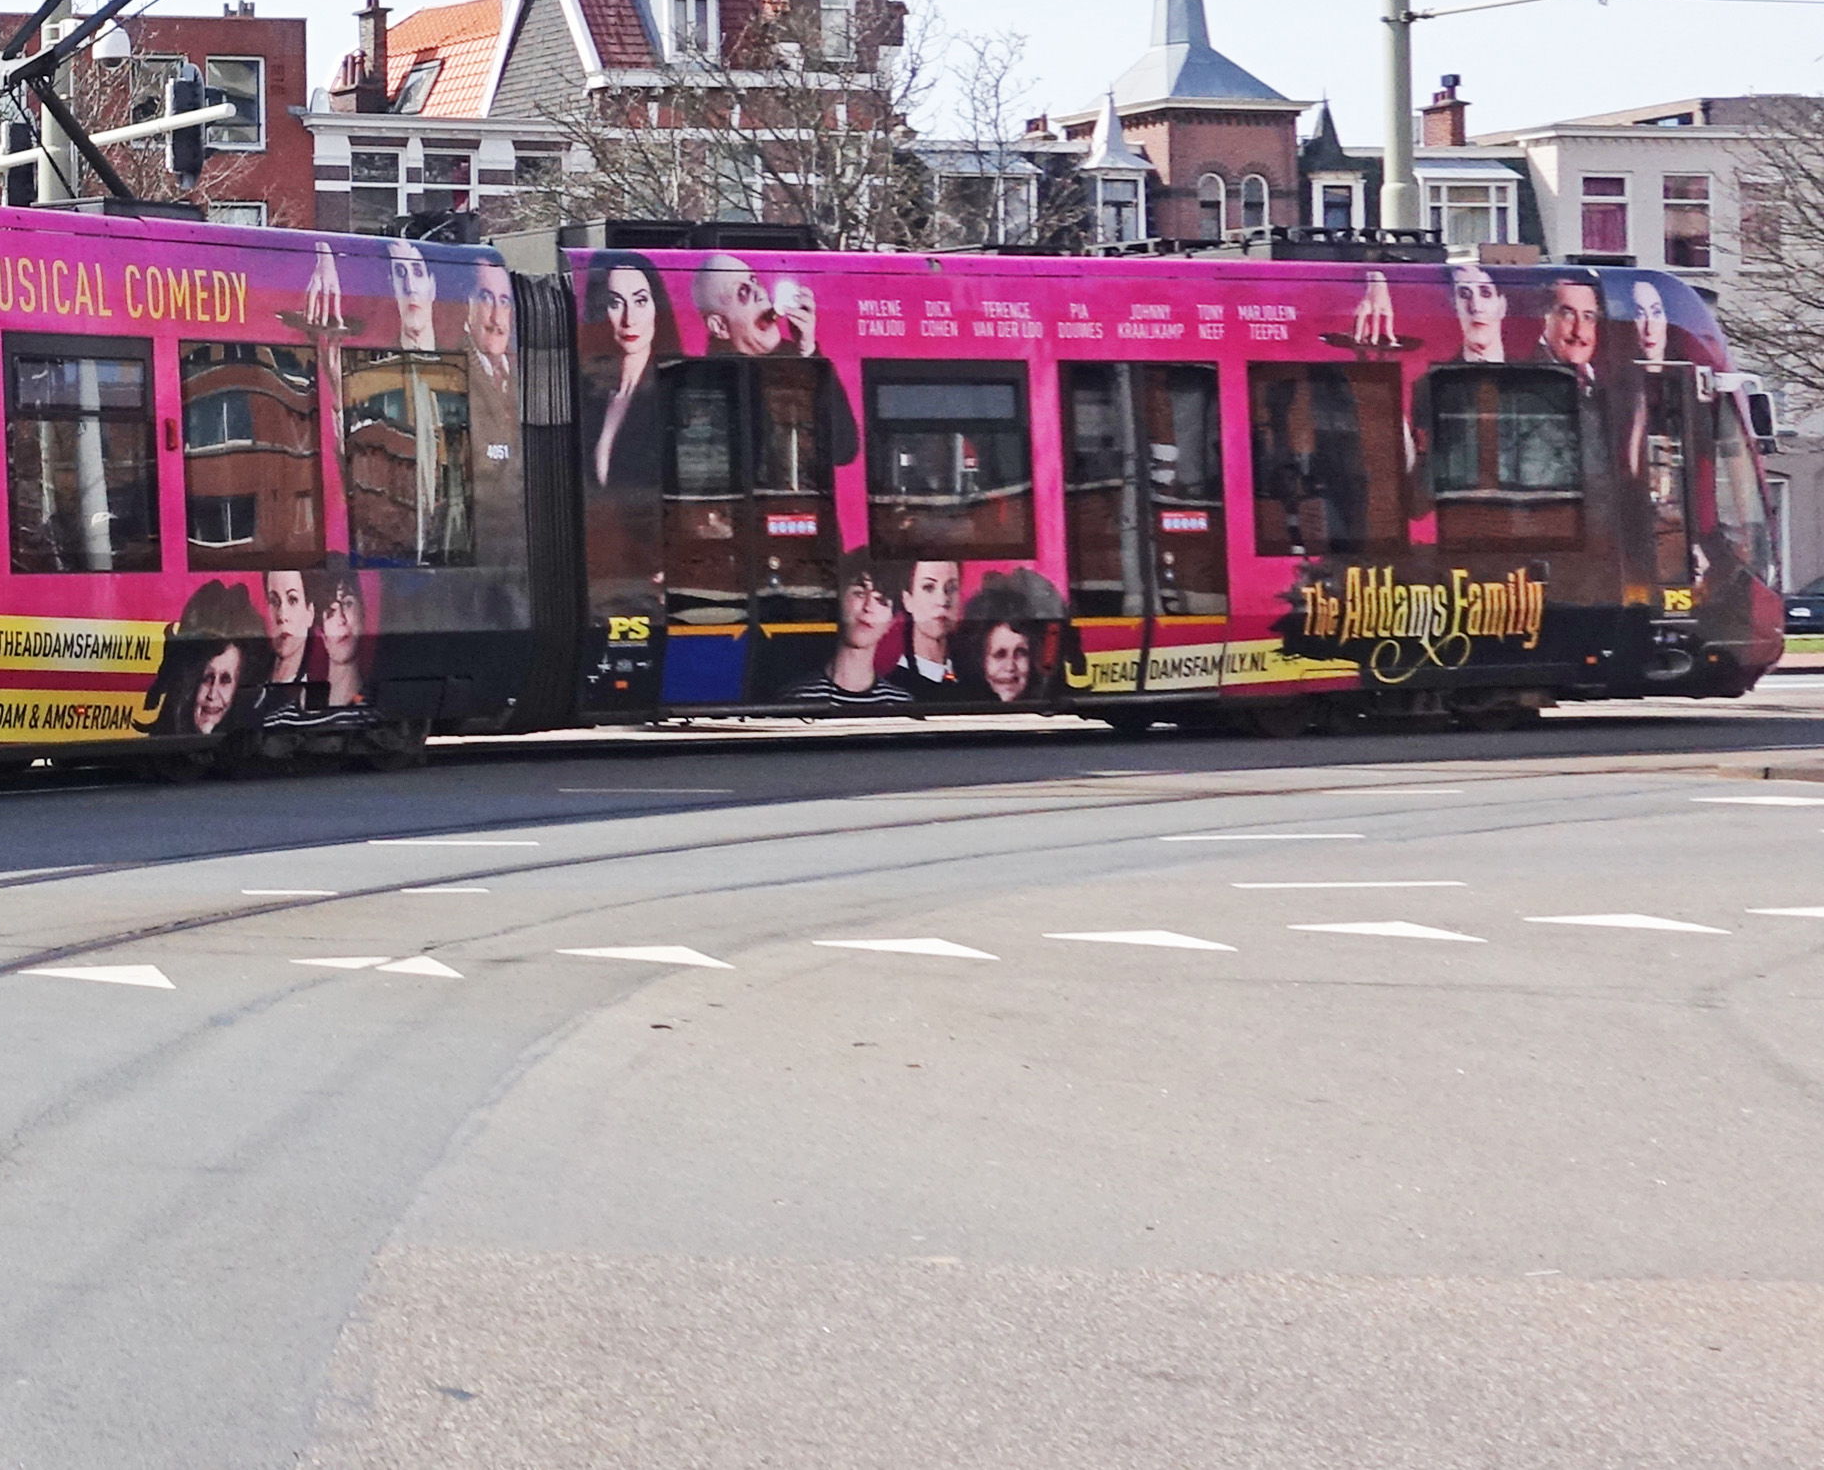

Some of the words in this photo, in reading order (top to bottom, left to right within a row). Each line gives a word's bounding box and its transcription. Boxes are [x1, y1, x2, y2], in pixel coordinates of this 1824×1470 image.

[124, 264, 246, 324] COMEDY
[1302, 581, 1339, 638] The
[1339, 565, 1448, 646] Addams
[1449, 567, 1544, 650] Family
[1663, 589, 1693, 611] PS
[608, 616, 650, 640] PS
[1091, 651, 1267, 685] THEADDAMSFAMILY.NL
[29, 705, 39, 729] &
[41, 704, 133, 730] AMSTERDAM
